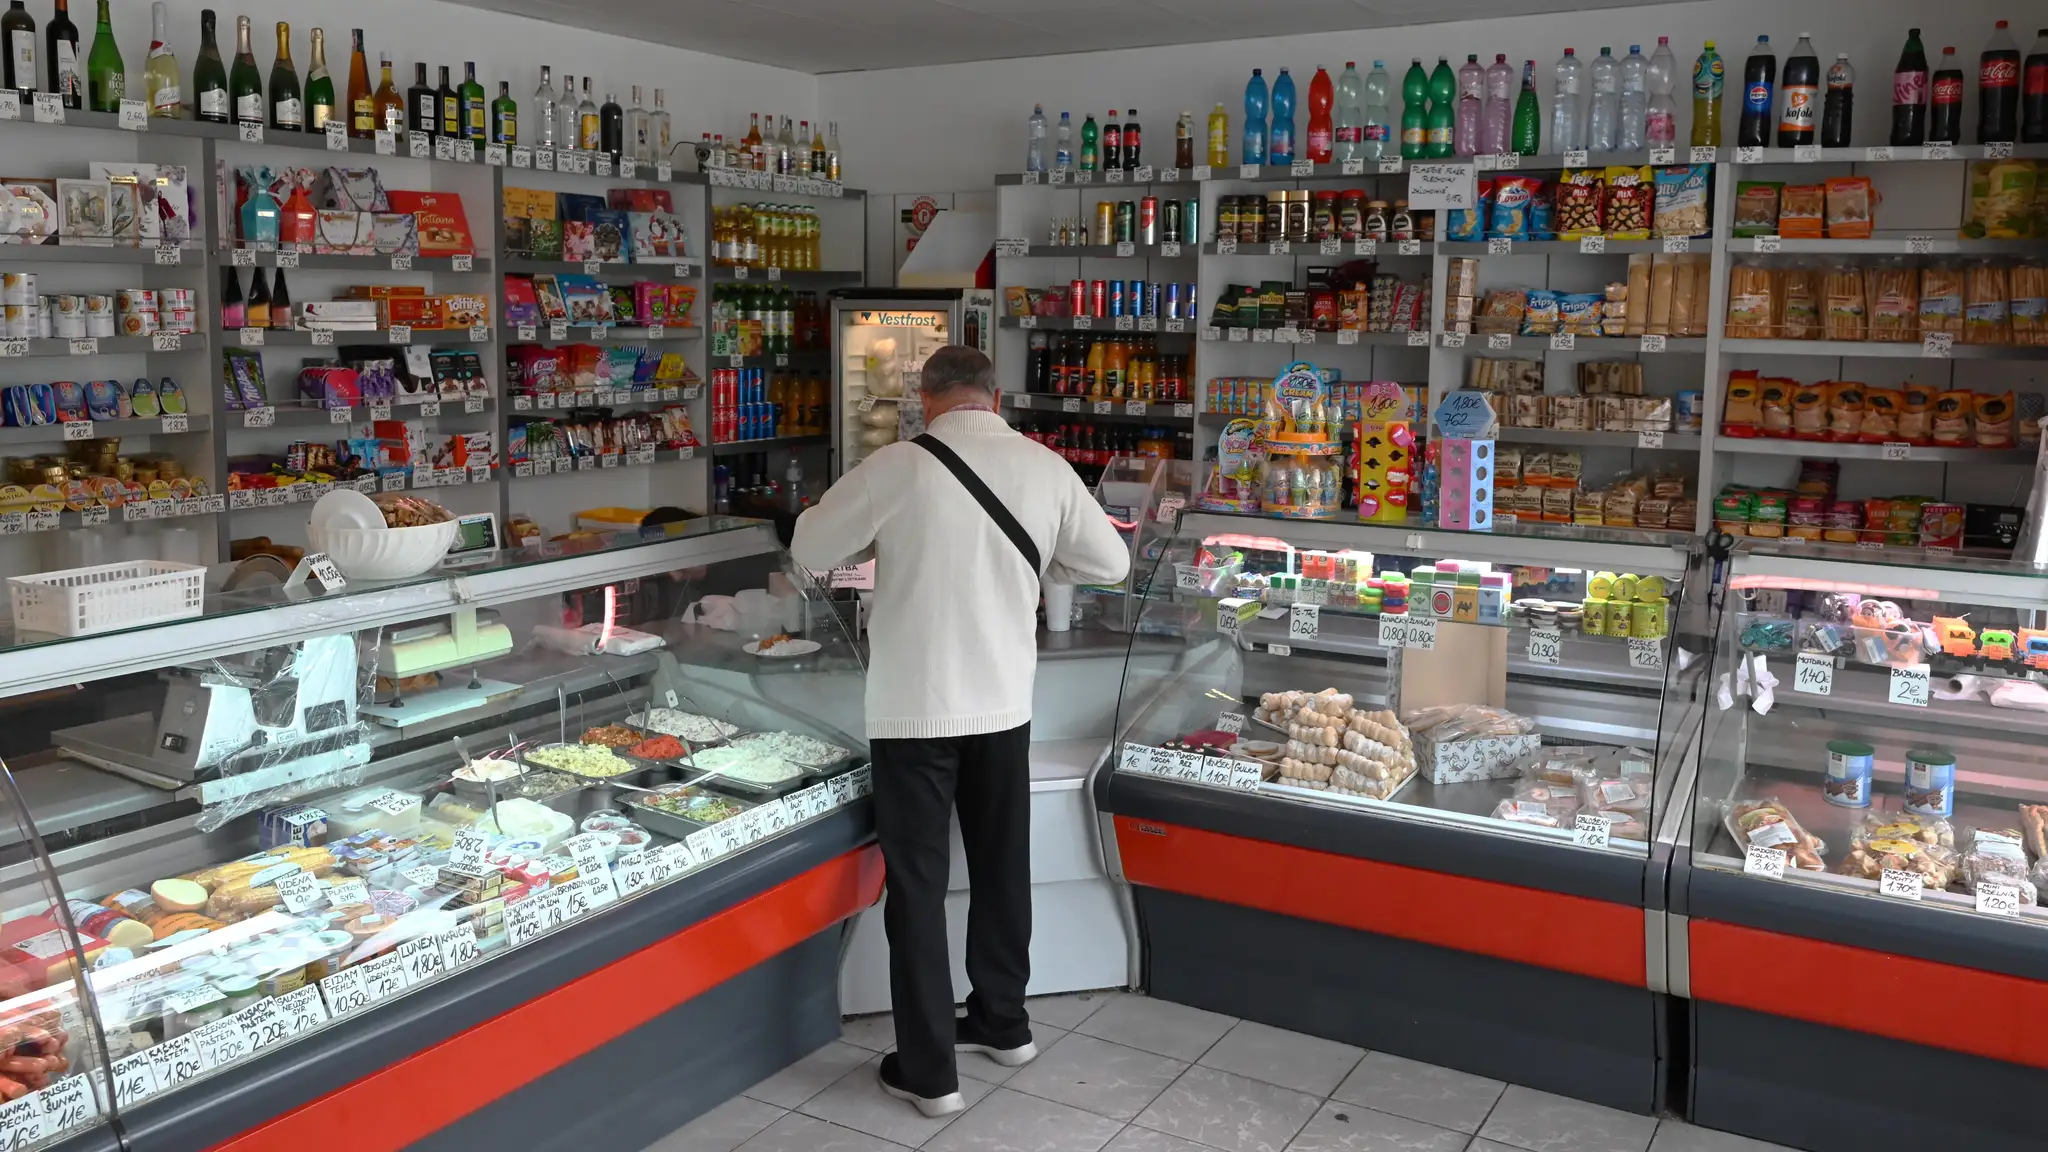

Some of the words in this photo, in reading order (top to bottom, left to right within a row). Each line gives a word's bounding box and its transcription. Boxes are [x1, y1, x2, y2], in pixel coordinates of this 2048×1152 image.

[1785, 106, 1813, 120] kofola
[446, 296, 486, 312] Toffifee
[878, 312, 936, 326] Vestfrost
[1282, 388, 1314, 400] CREAM
[1452, 396, 1482, 410] 1,80€
[1444, 412, 1470, 427] 762
[1292, 619, 1318, 635] 0,60€
[1532, 642, 1559, 658] 0,30€
[1797, 656, 1832, 668] MOTORKA
[1800, 667, 1830, 684] 1,40€
[1898, 682, 1920, 700] 2€
[1126, 754, 1139, 768] 1€
[454, 837, 485, 854] 2,80€
[340, 893, 356, 903] SYR
[1984, 896, 2017, 910] 1,20€
[401, 935, 434, 959] LUNEX
[412, 951, 443, 980] 1,80€
[323, 968, 358, 989] EIDAM
[329, 979, 357, 995] TEHLA
[378, 977, 400, 1000] 17€
[334, 986, 371, 1015] 10,50€
[236, 998, 274, 1023] HUSACIA
[249, 1021, 287, 1052] 2,20€
[148, 1036, 191, 1059] KAČACIA
[209, 1040, 245, 1066] 1,50€
[163, 1060, 201, 1085] 1,80€
[57, 1104, 88, 1130] 11€
